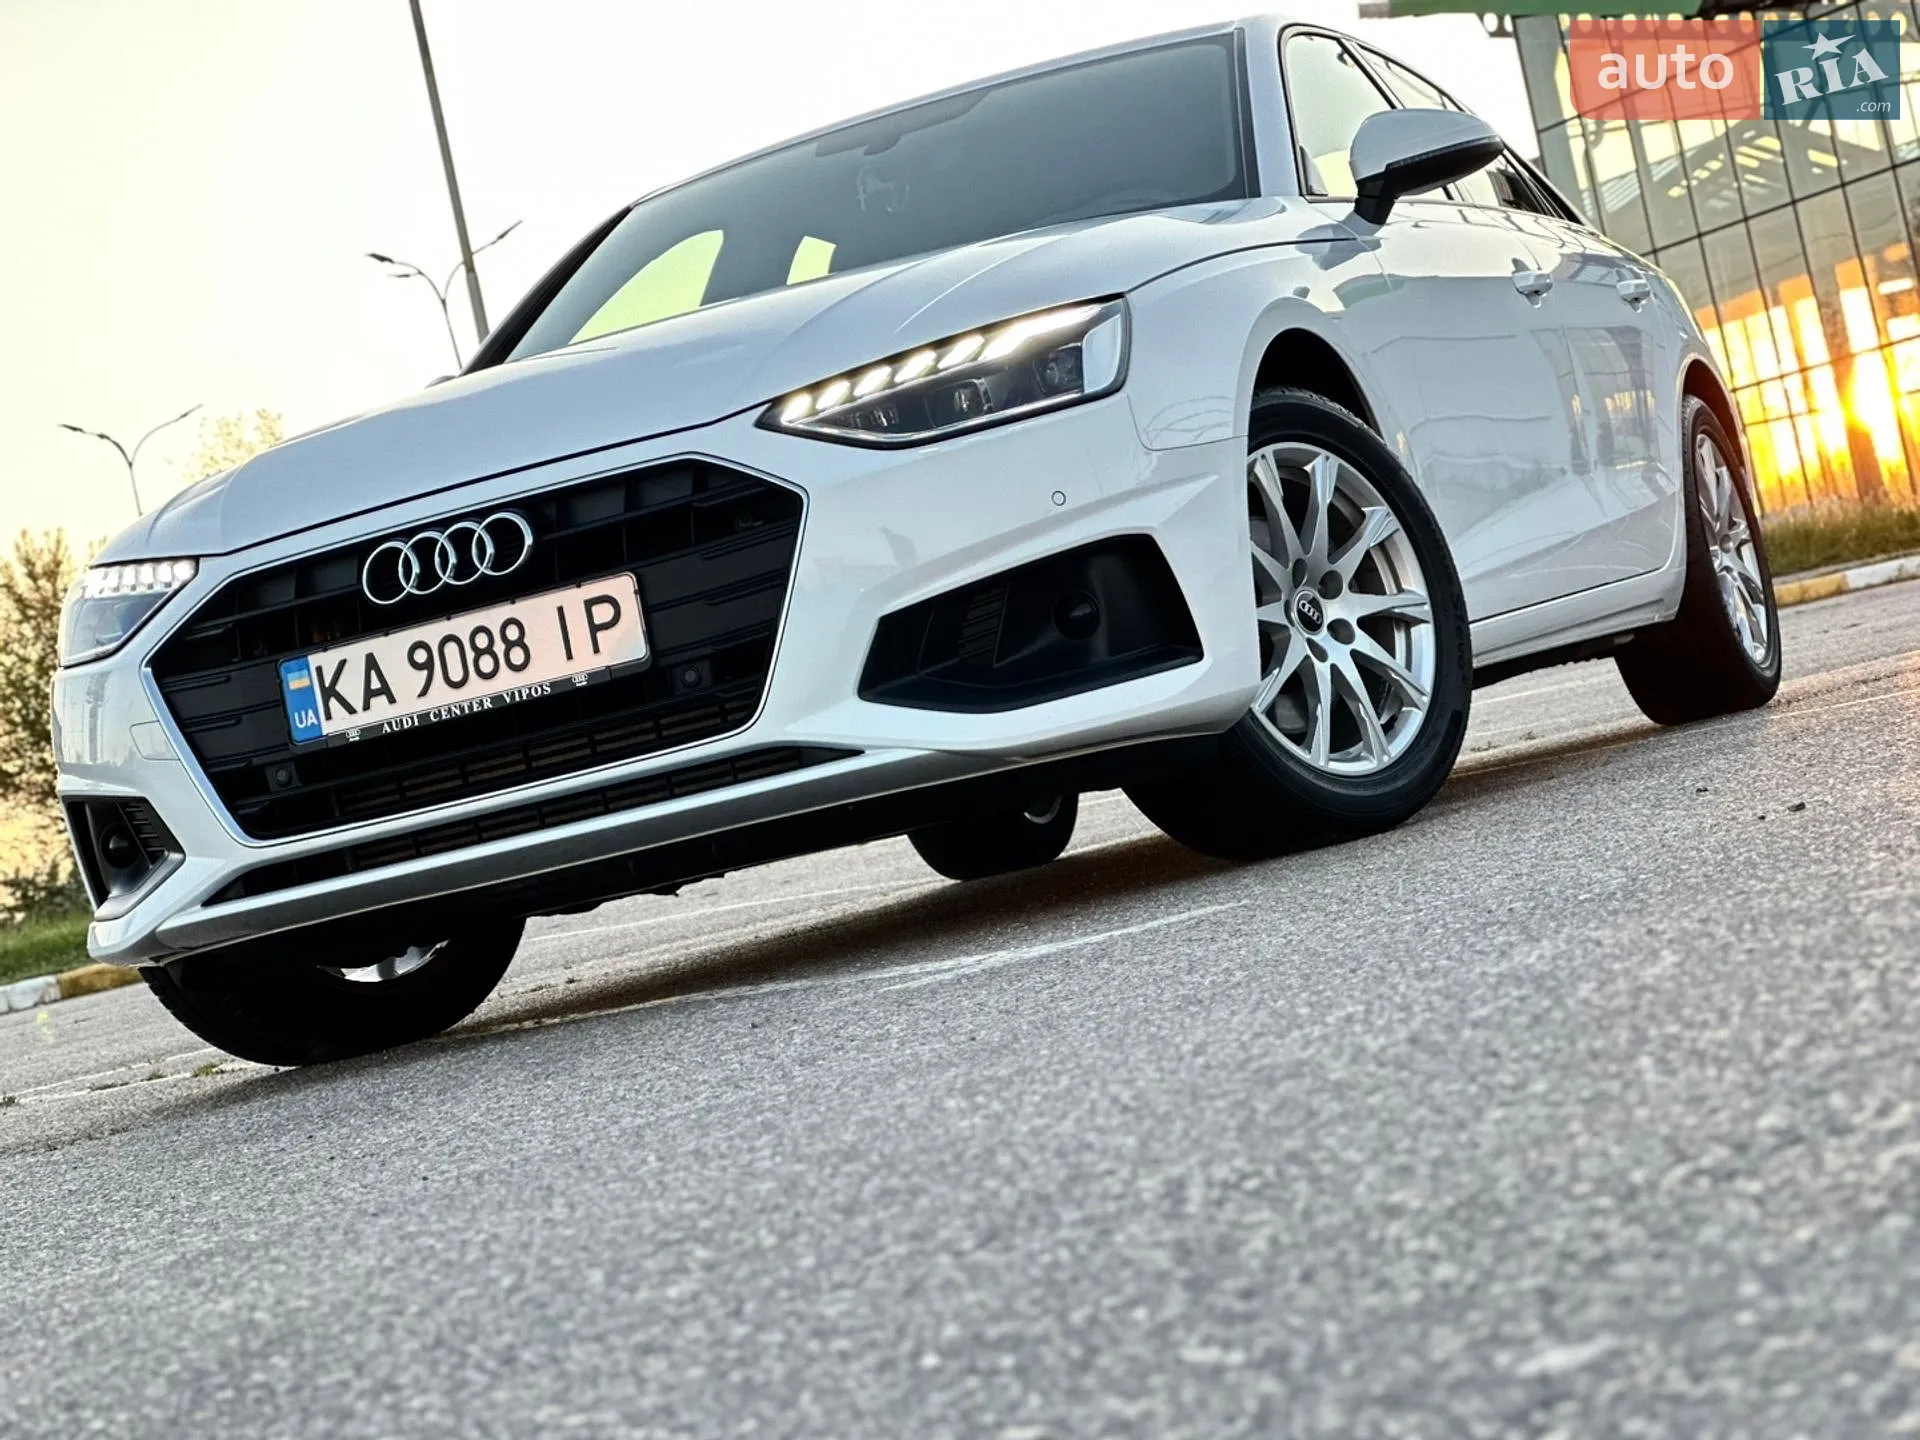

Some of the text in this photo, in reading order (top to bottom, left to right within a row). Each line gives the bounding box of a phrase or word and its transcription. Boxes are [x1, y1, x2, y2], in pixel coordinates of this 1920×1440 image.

[314, 594, 622, 721] KA 9088 IP
[294, 708, 318, 729] UA
[381, 682, 552, 734] AUDI CENTER VIPOS
